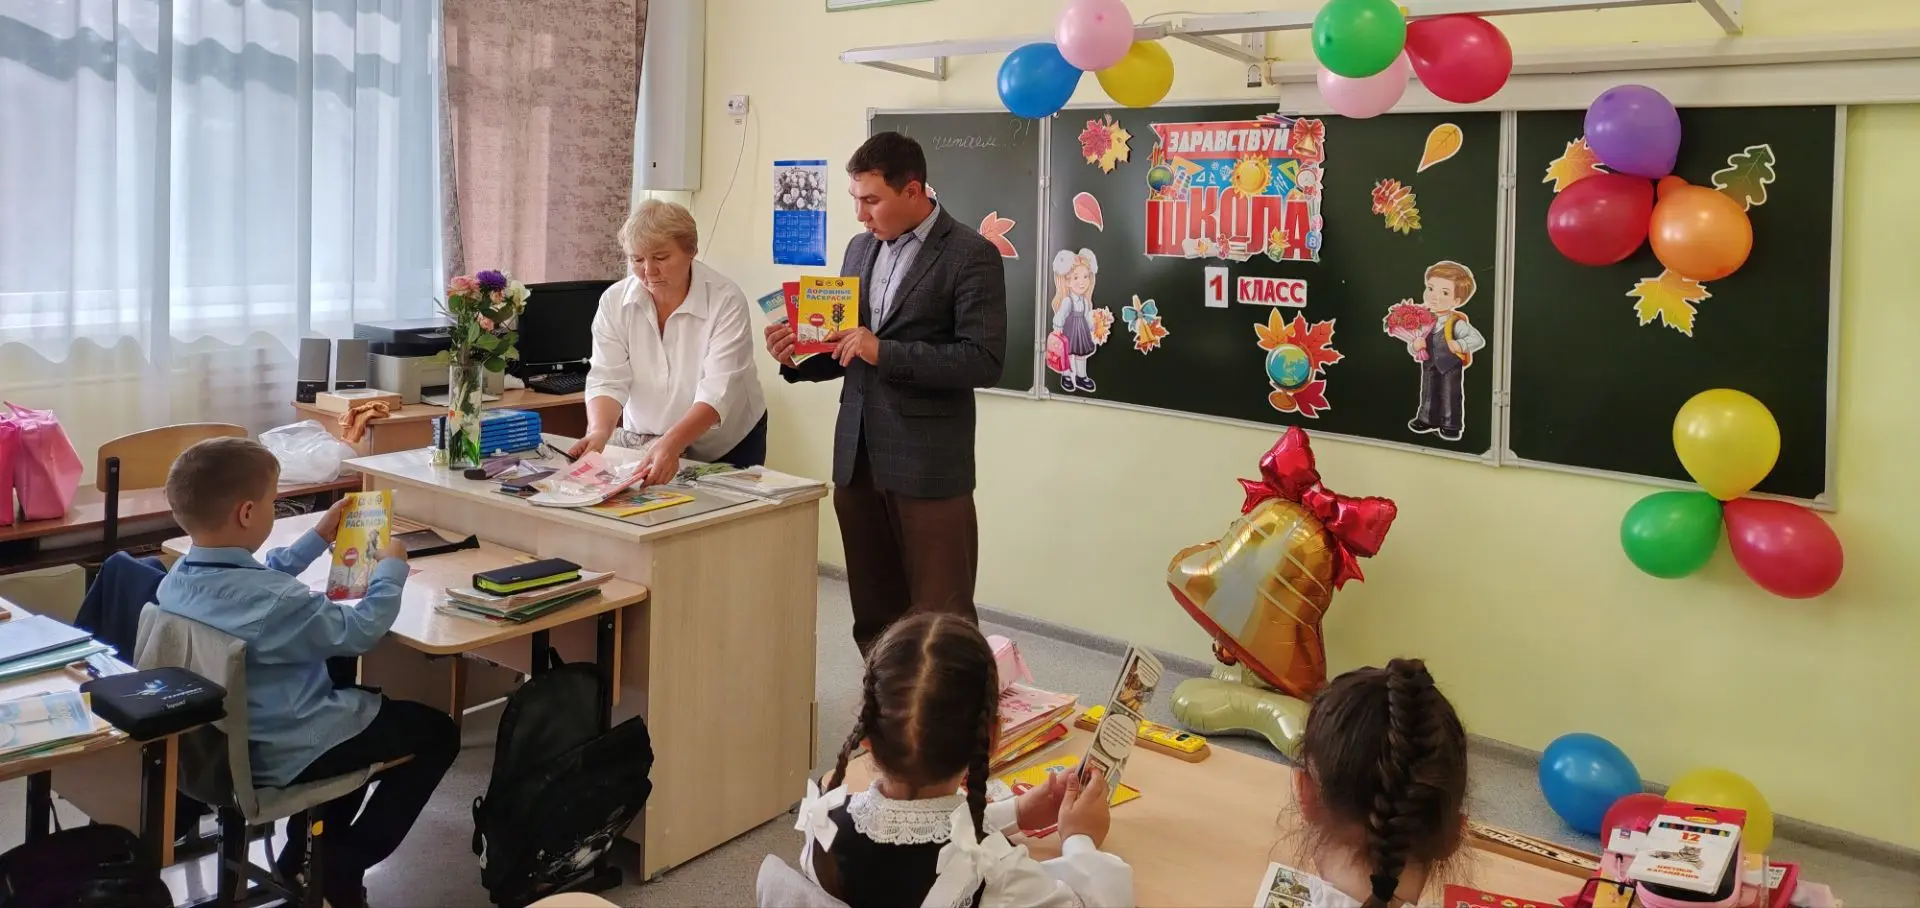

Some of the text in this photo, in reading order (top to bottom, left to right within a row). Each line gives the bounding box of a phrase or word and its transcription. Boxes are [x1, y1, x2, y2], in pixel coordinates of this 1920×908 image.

[1146, 186, 1313, 259] ШКОЛА
[1209, 275, 1223, 301] 1
[1239, 279, 1305, 304] КЛАСС
[1682, 832, 1702, 841] 12
